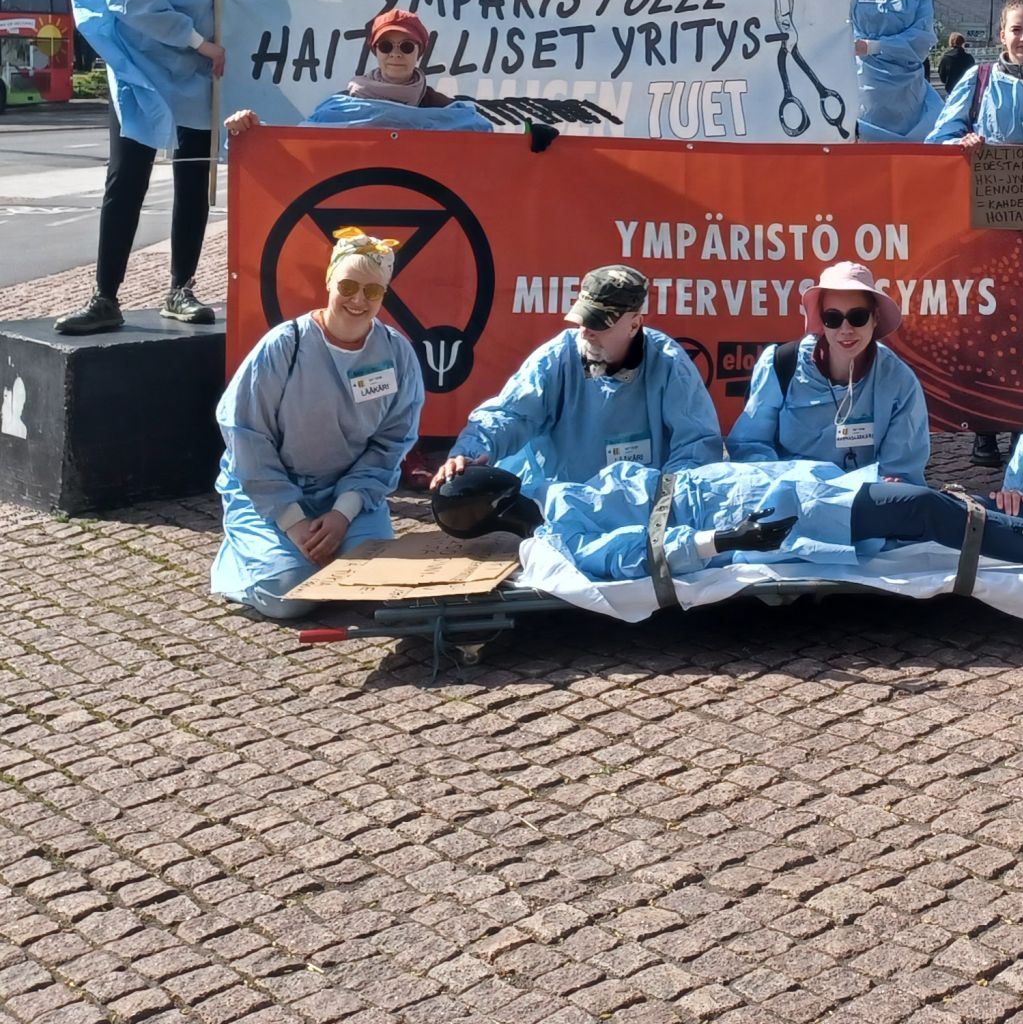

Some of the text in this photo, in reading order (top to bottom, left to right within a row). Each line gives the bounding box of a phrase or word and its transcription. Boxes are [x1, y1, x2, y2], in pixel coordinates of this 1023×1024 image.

[251, 17, 789, 84] HAITLLISET YRITYS-
[648, 79, 747, 138] TUET
[615, 212, 909, 261] YMPÄRISTÖ ON
